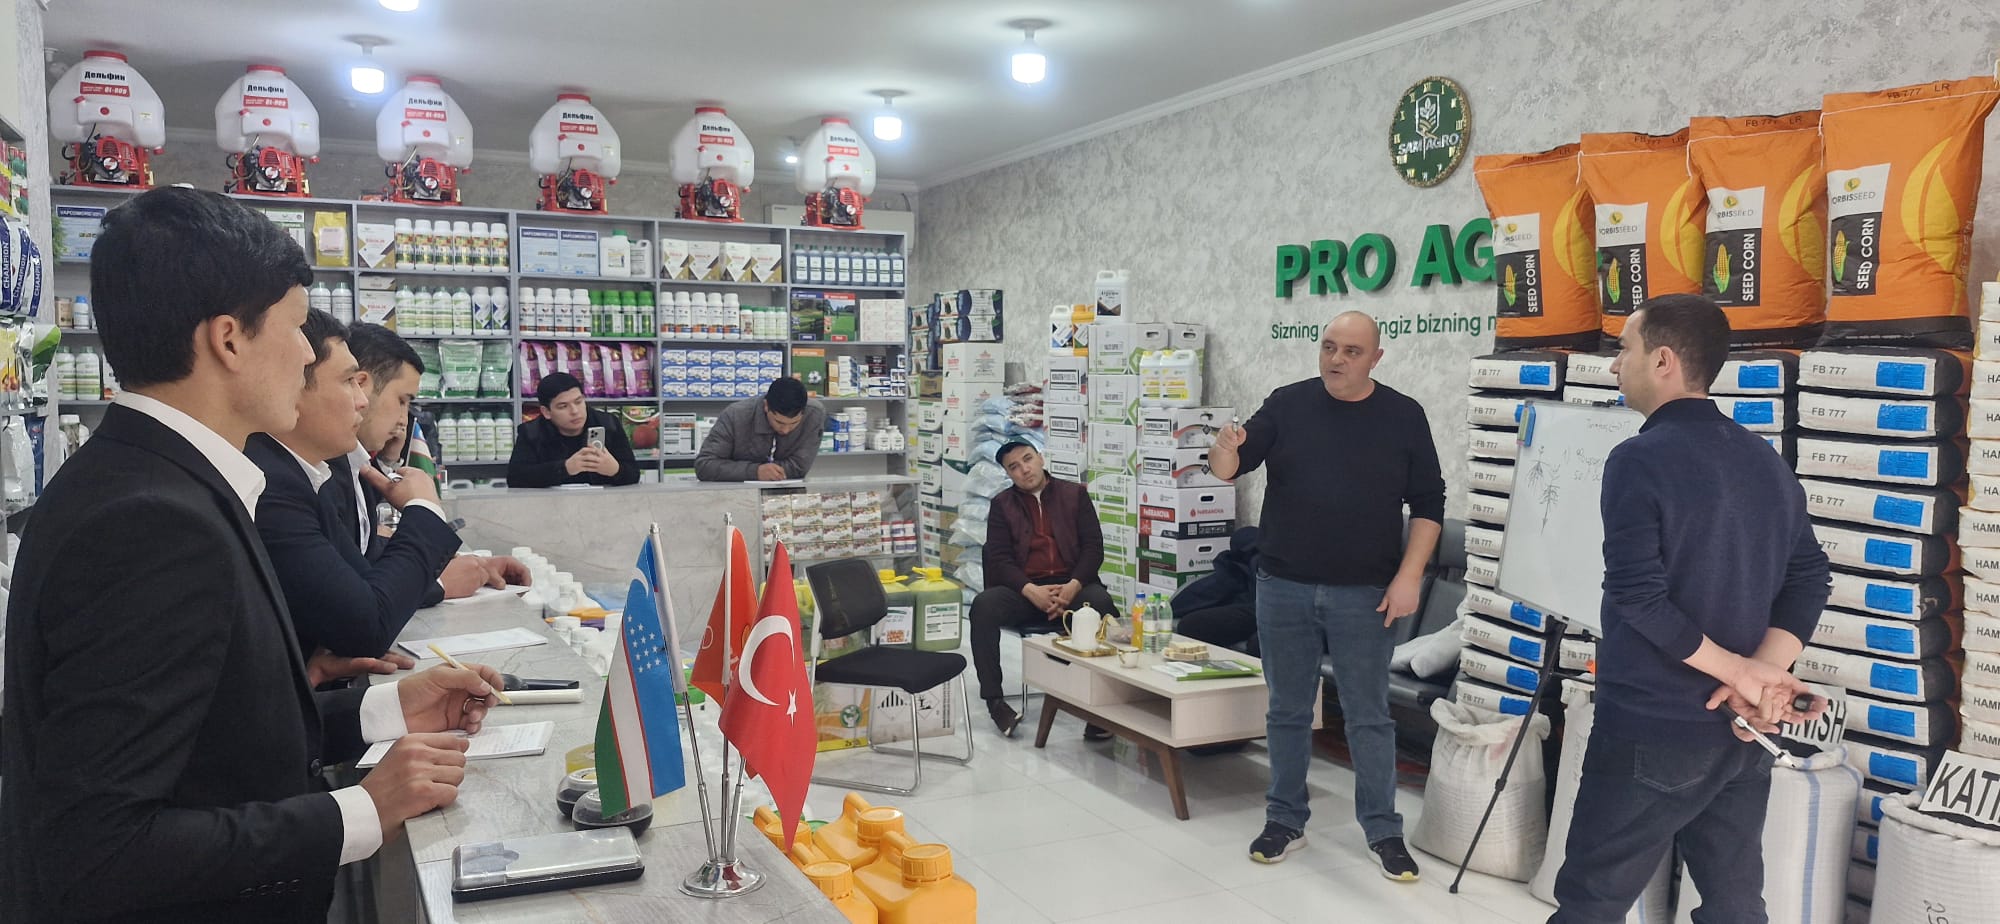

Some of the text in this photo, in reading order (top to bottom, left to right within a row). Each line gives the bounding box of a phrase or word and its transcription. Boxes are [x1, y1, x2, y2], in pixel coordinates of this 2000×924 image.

[84, 71, 126, 81] Дельфин
[247, 84, 285, 94] Дельфин
[1903, 87, 1922, 96] 777
[1934, 83, 1951, 92] LR
[1745, 119, 1759, 127] FB
[1831, 191, 1876, 205] ORBISSEED
[1276, 217, 1497, 299] PRO AG
[1856, 217, 1875, 290] SEED CORN
[1742, 233, 1755, 302] SEED CORN
[13, 254, 27, 298] CHAMPION
[1629, 248, 1643, 310] EED CORN
[1525, 254, 1538, 313] SEED CORN
[1271, 321, 1319, 342] Sizning
[1417, 312, 1481, 337] bizning
[1478, 368, 1501, 377] FB 777
[1576, 364, 1601, 374] FB 777
[1812, 364, 1847, 376] FB 777
[1485, 407, 1497, 415] 777
[1811, 407, 1847, 419] FB 777
[1476, 440, 1498, 449] FB 777
[1811, 452, 1848, 464] FB 777
[1474, 472, 1497, 481] FB 777
[1809, 494, 1845, 507] FB 777
[1472, 504, 1494, 514] FB 777
[1481, 539, 1493, 547] 777
[1482, 568, 1494, 577] 777
[1481, 596, 1492, 605] 777
[1818, 623, 1835, 634] 777
[1479, 630, 1491, 639] 777
[1579, 652, 1592, 660] 777
[1476, 662, 1487, 671] 777
[1805, 660, 1839, 675] FB 777
[1473, 695, 1485, 704] 777
